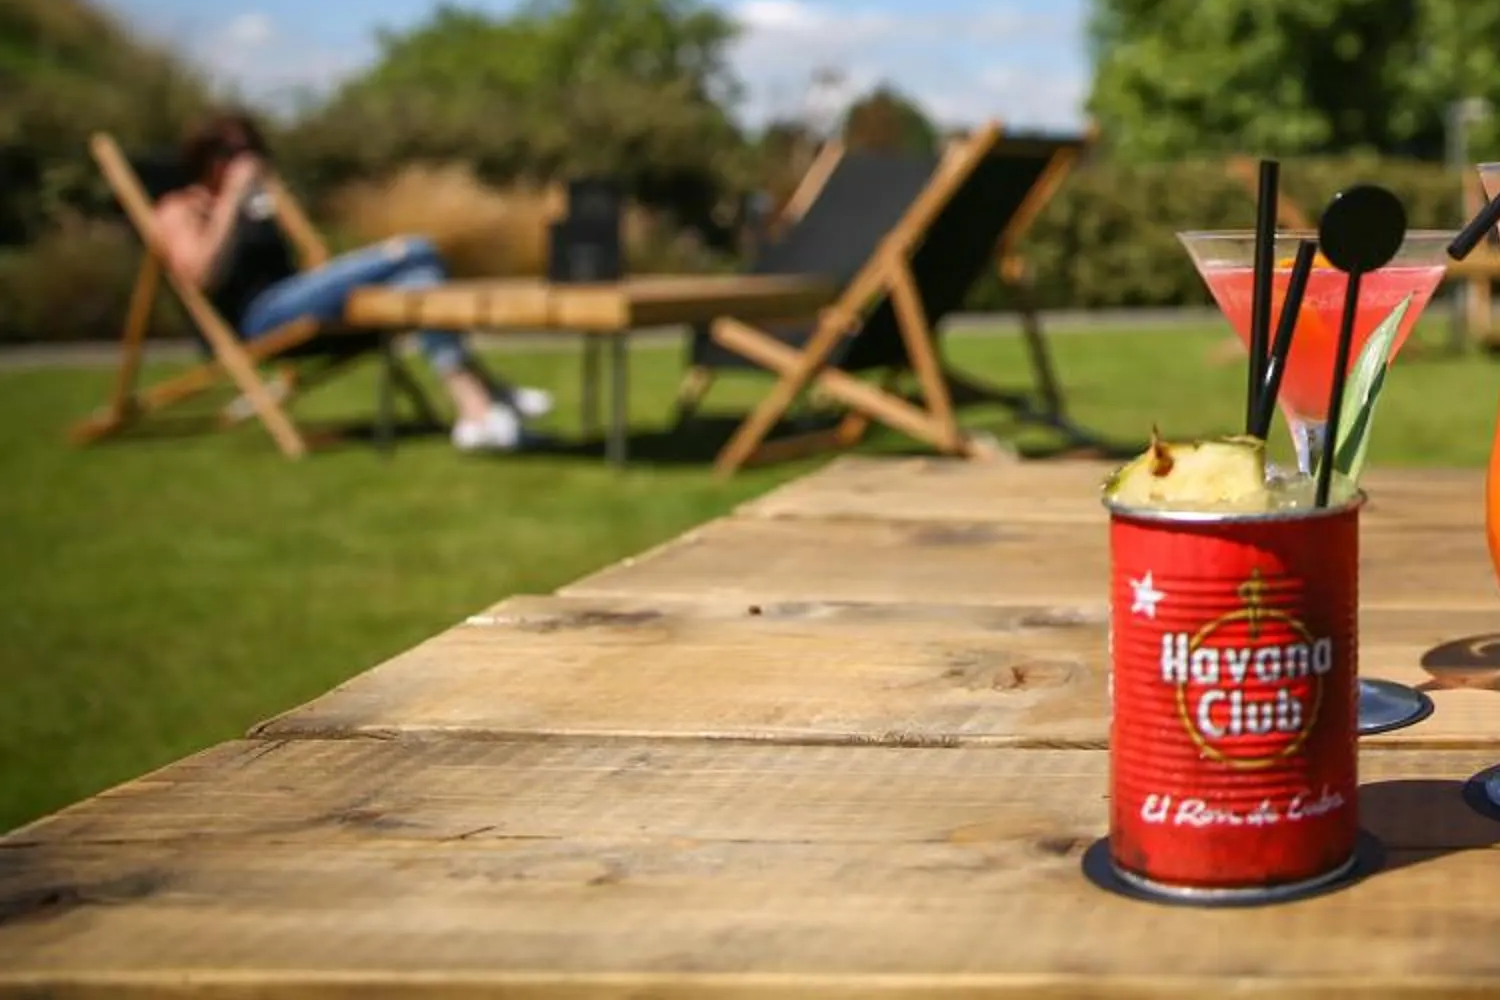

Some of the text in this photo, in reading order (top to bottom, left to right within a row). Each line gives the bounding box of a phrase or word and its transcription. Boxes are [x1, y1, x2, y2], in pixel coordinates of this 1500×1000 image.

[1161, 632, 1332, 684] Havana
[1197, 689, 1302, 738] Club
[1141, 793, 1171, 823] El
[1175, 797, 1243, 827] Ron
